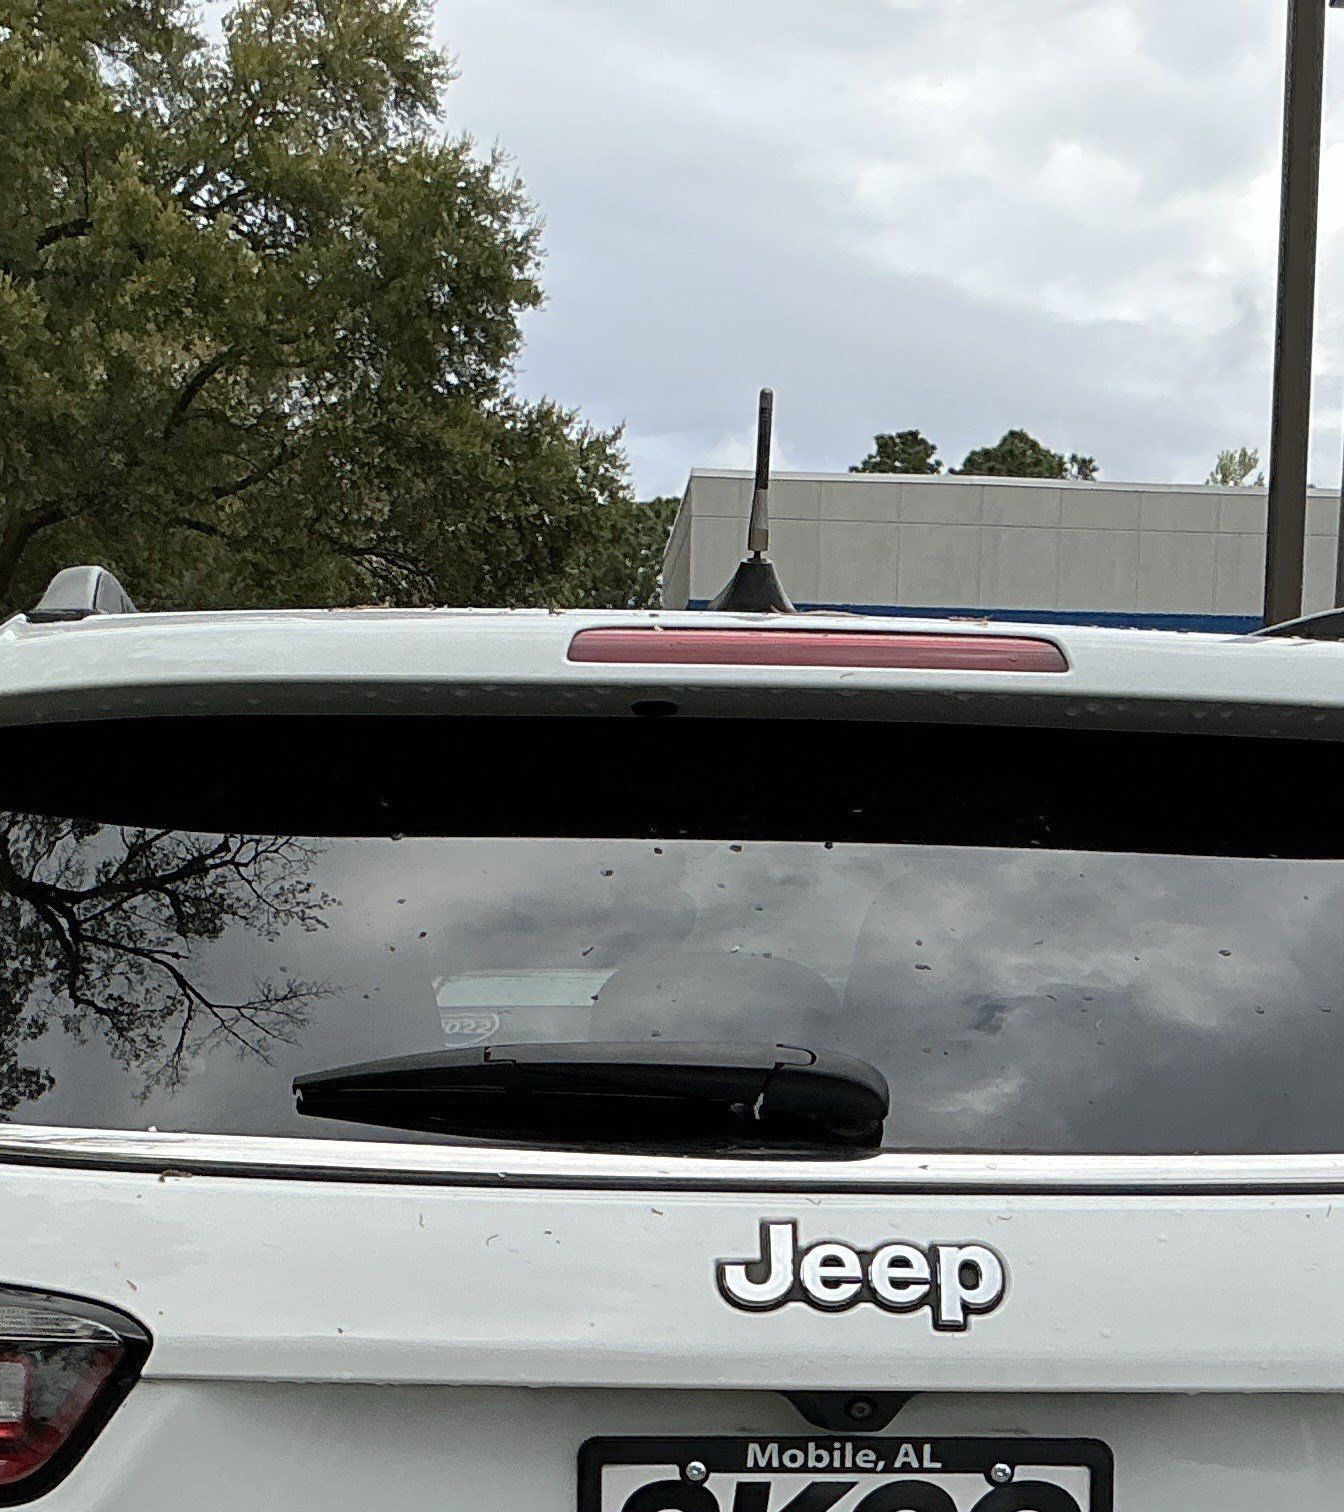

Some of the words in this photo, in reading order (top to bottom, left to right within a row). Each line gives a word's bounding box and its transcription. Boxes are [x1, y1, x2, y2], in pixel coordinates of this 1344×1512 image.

[716, 1219, 1004, 1331] Jeep
[745, 1441, 887, 1472] Mobile,
[892, 1442, 944, 1469] AL
